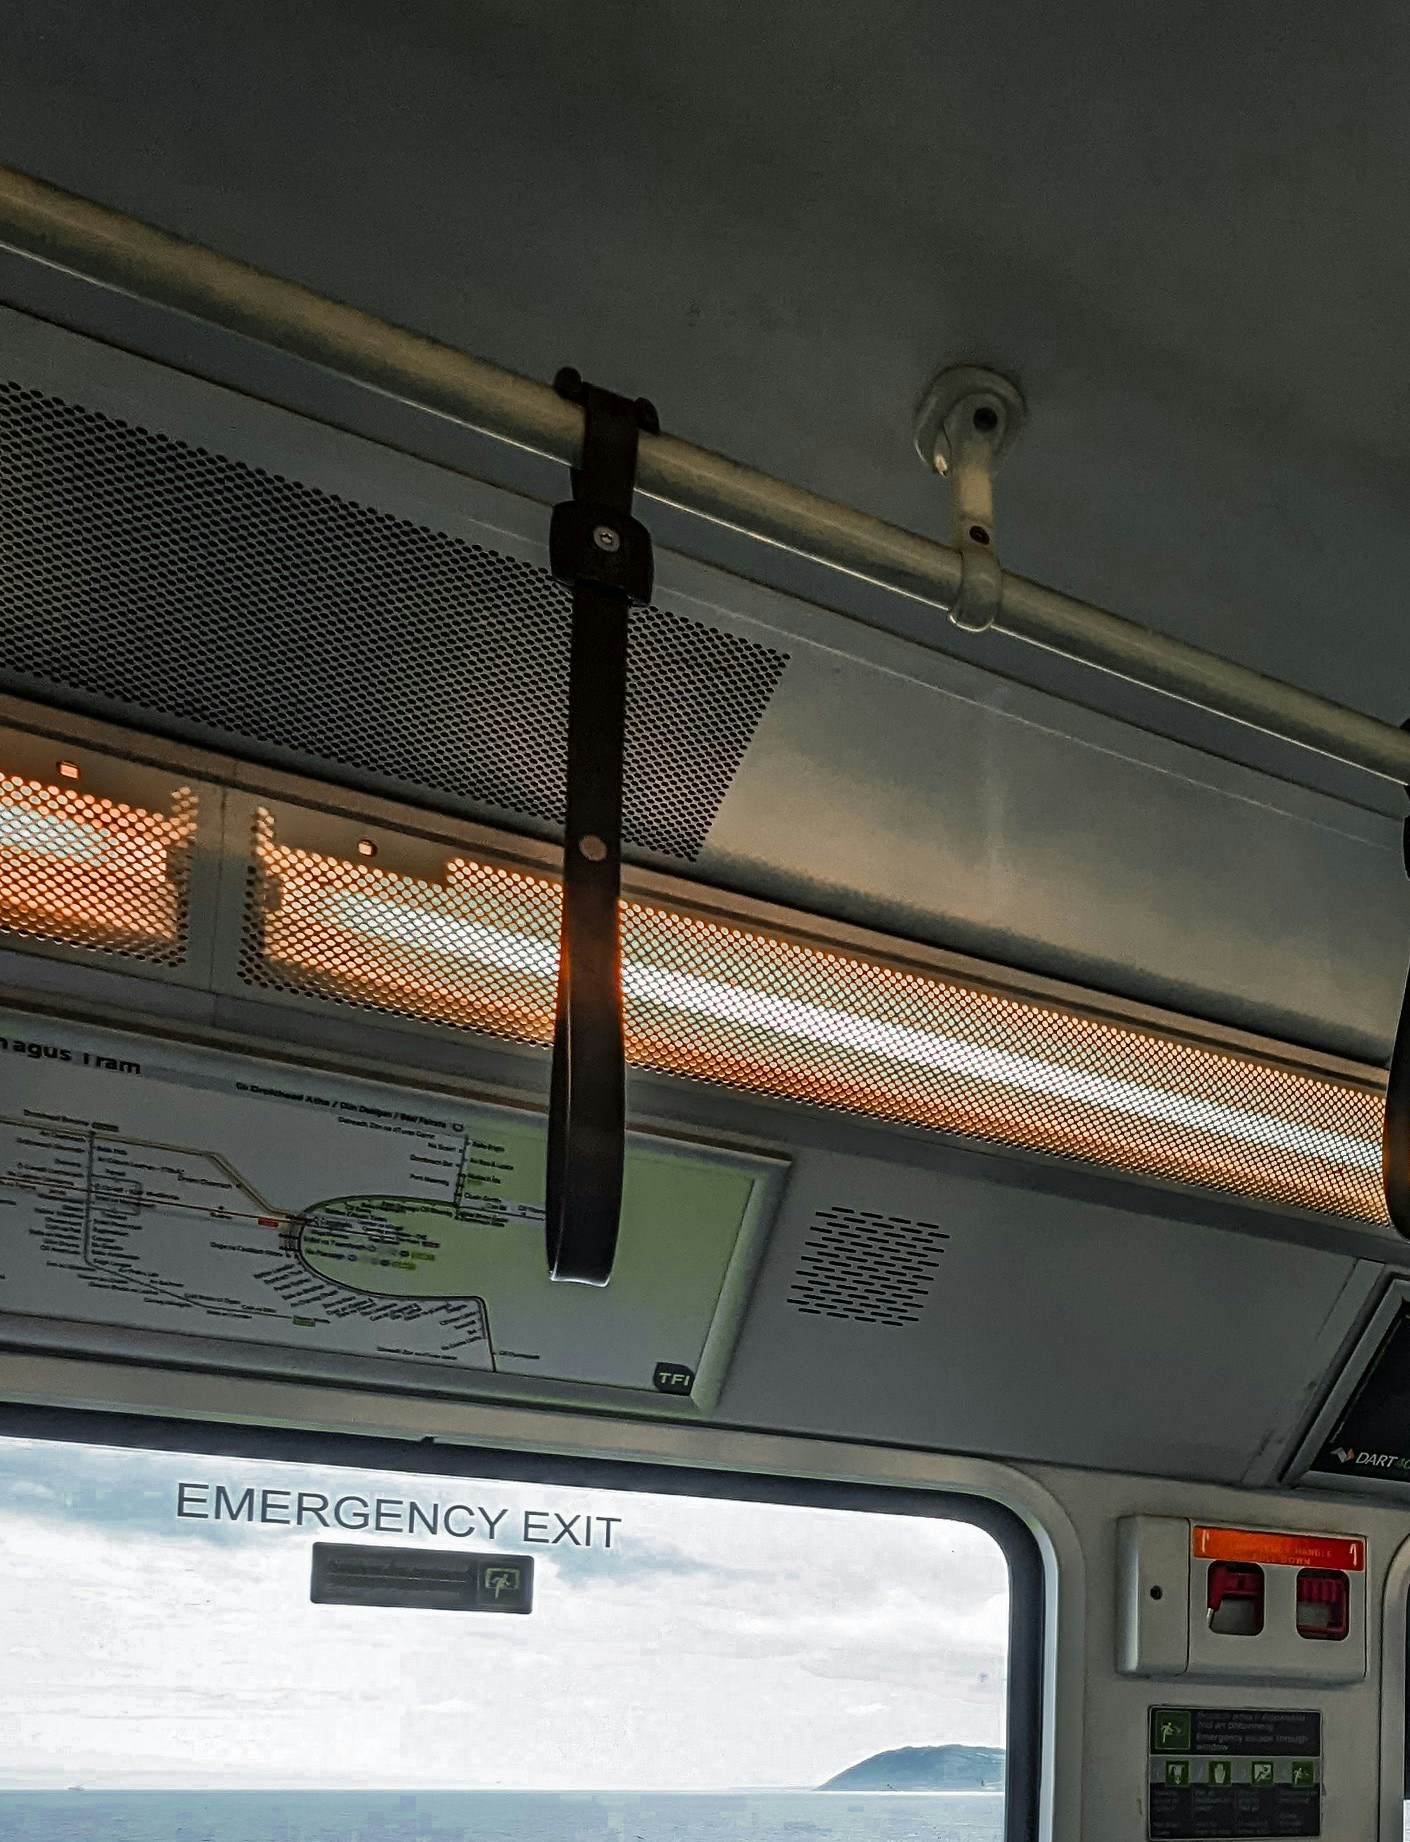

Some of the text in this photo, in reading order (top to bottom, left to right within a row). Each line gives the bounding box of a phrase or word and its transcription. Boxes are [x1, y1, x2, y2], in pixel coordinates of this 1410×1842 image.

[13, 1040, 73, 1061] agus
[659, 1372, 690, 1386] TFI
[177, 1482, 623, 1548] EMERGENCY EXIT
